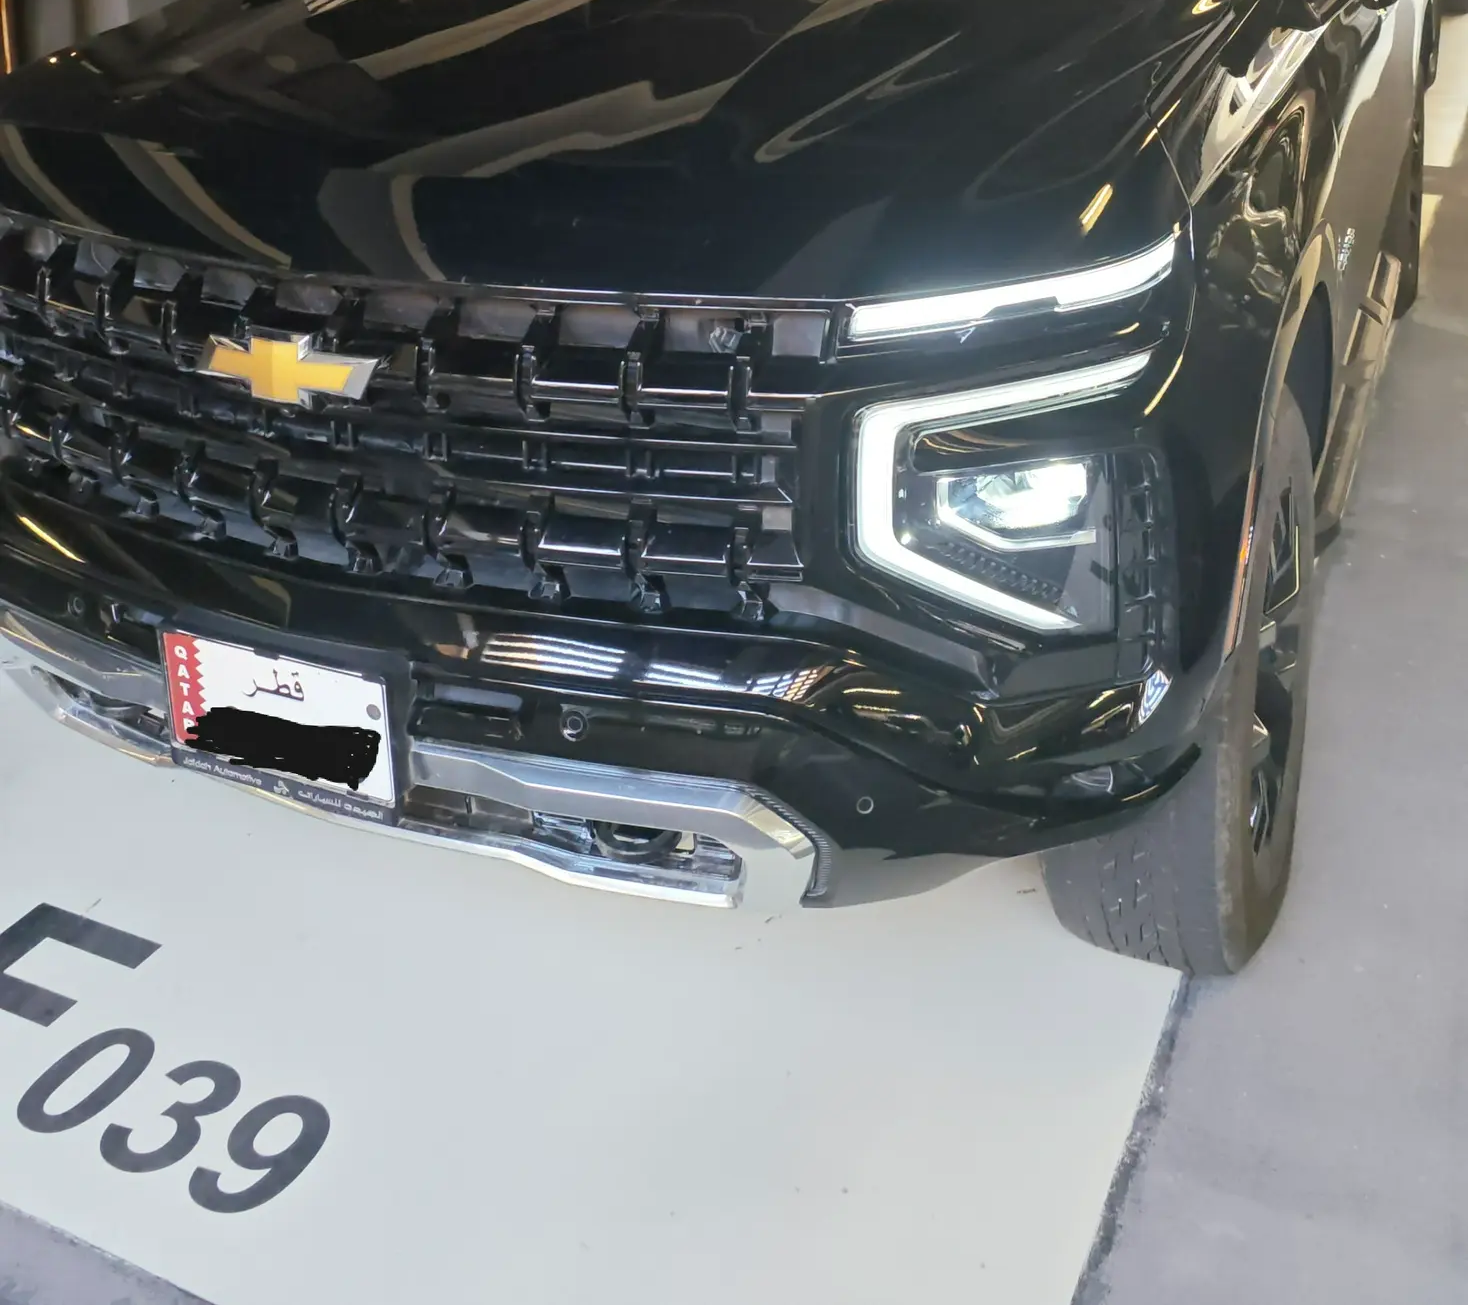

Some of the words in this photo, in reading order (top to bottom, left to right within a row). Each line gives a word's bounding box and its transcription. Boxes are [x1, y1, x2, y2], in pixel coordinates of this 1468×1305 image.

[243, 668, 305, 702] قطر
[213, 764, 262, 786] Automotive
[16, 1027, 331, 1214] 039
